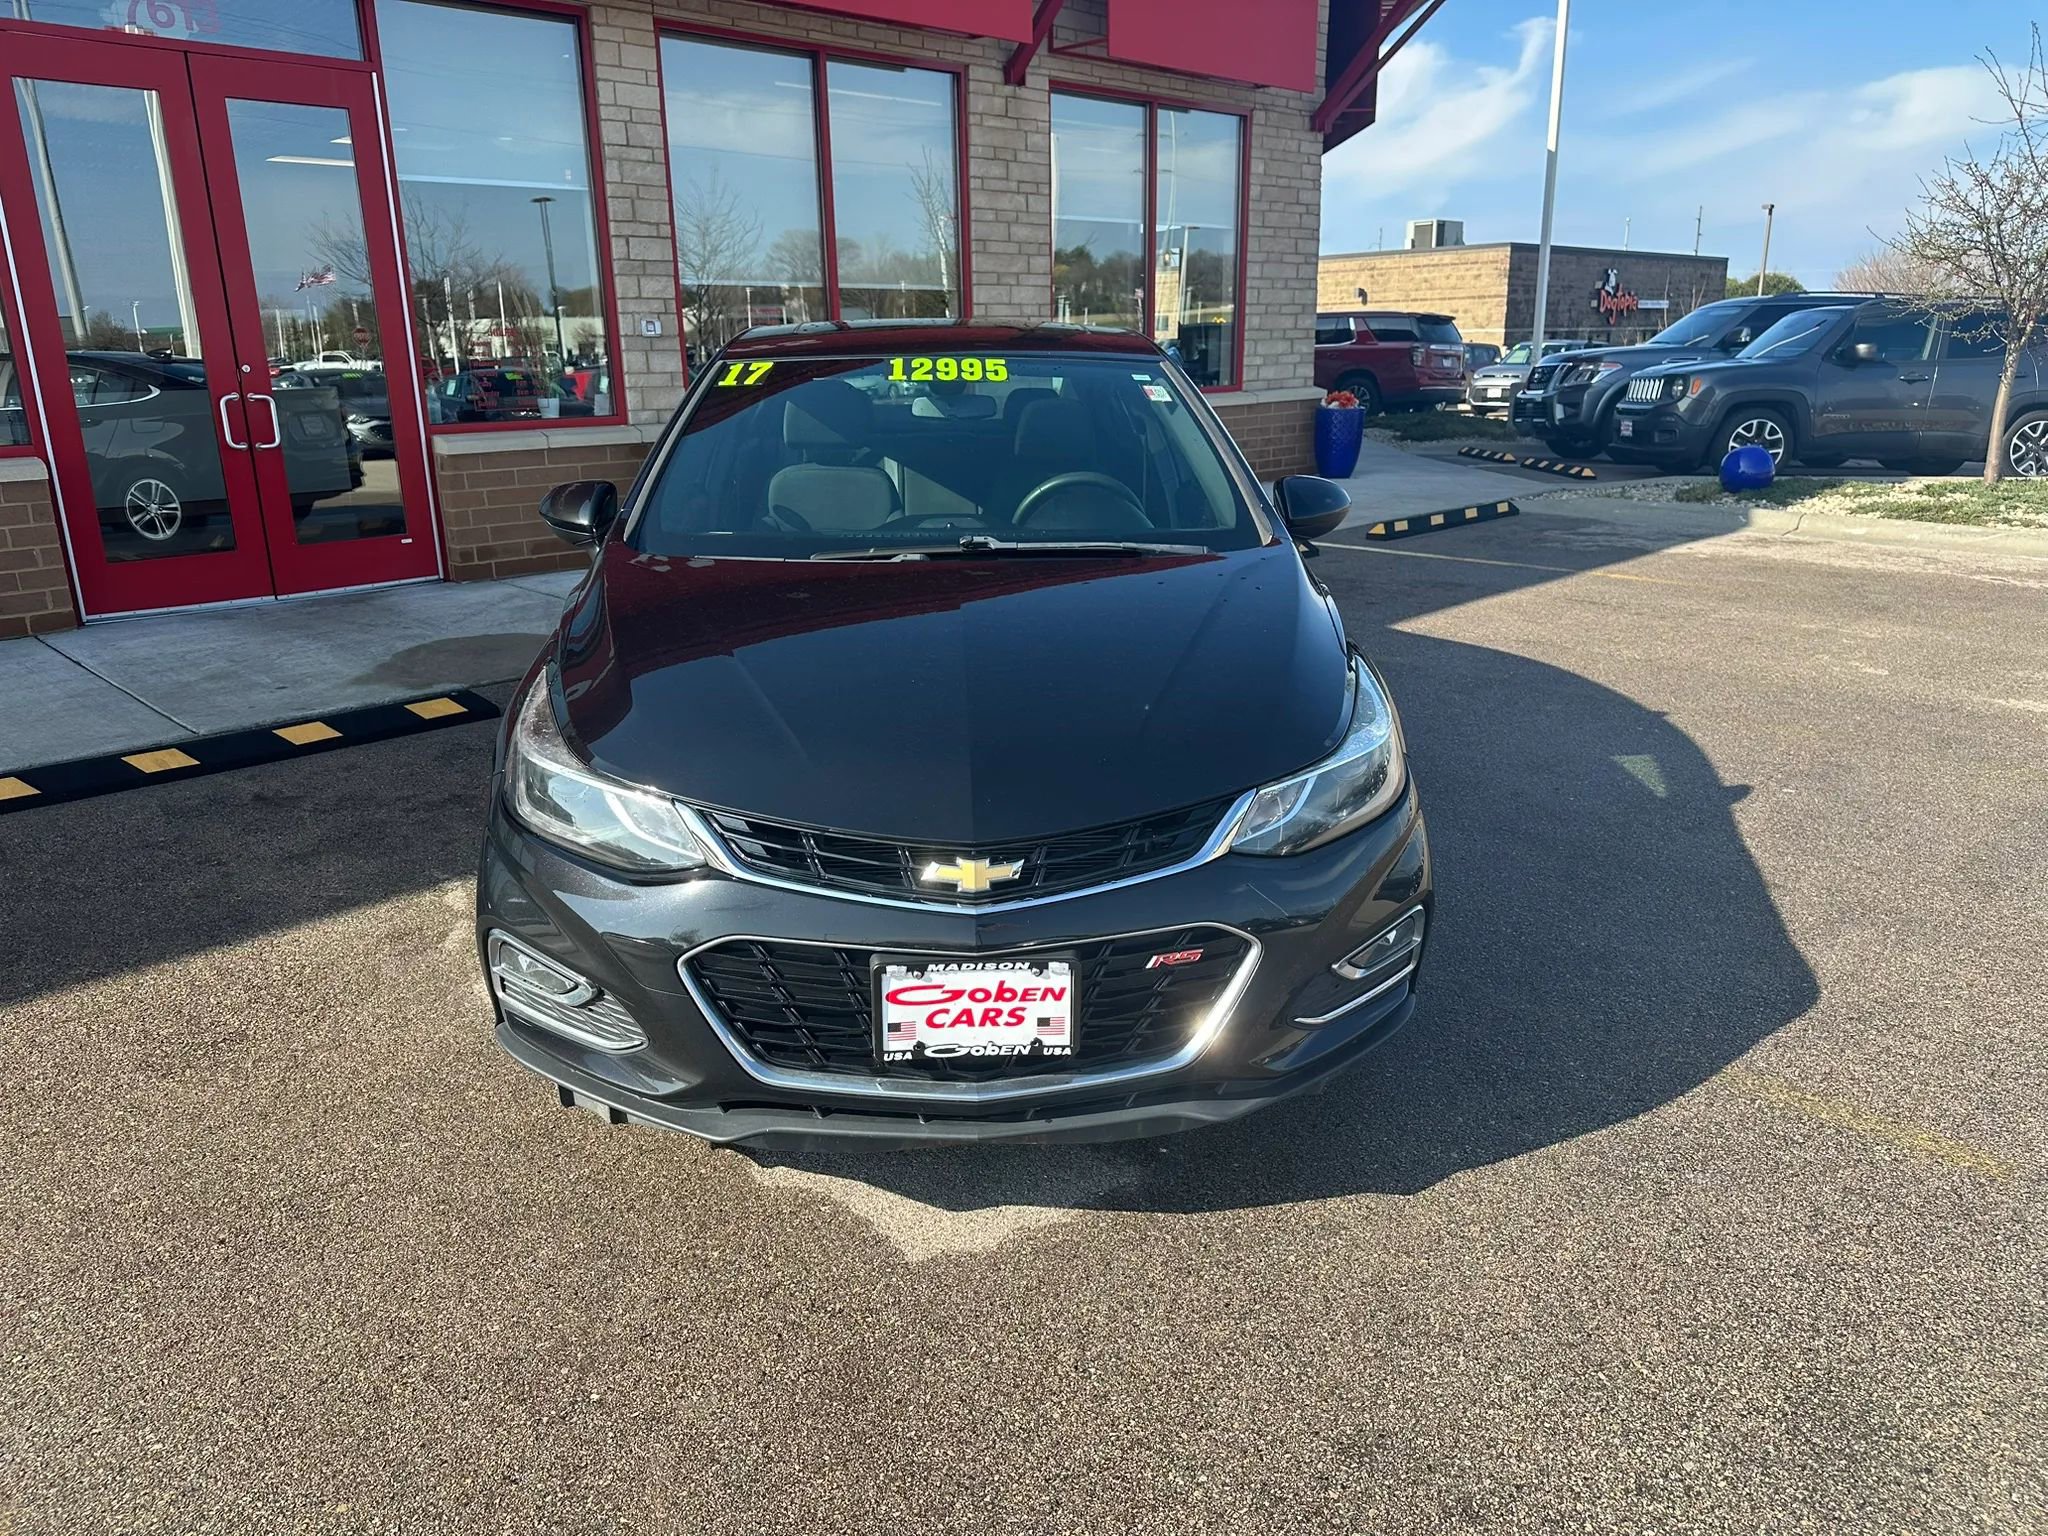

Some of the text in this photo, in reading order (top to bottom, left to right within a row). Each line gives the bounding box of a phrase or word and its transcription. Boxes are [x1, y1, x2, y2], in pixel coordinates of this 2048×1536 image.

[718, 361, 774, 386] 17
[888, 358, 1009, 382] 12995
[926, 962, 1030, 973] MADISON
[1145, 948, 1204, 969] RS
[925, 1006, 1027, 1029] CARS
[884, 1051, 913, 1062] USA
[1043, 1047, 1072, 1056] USA
